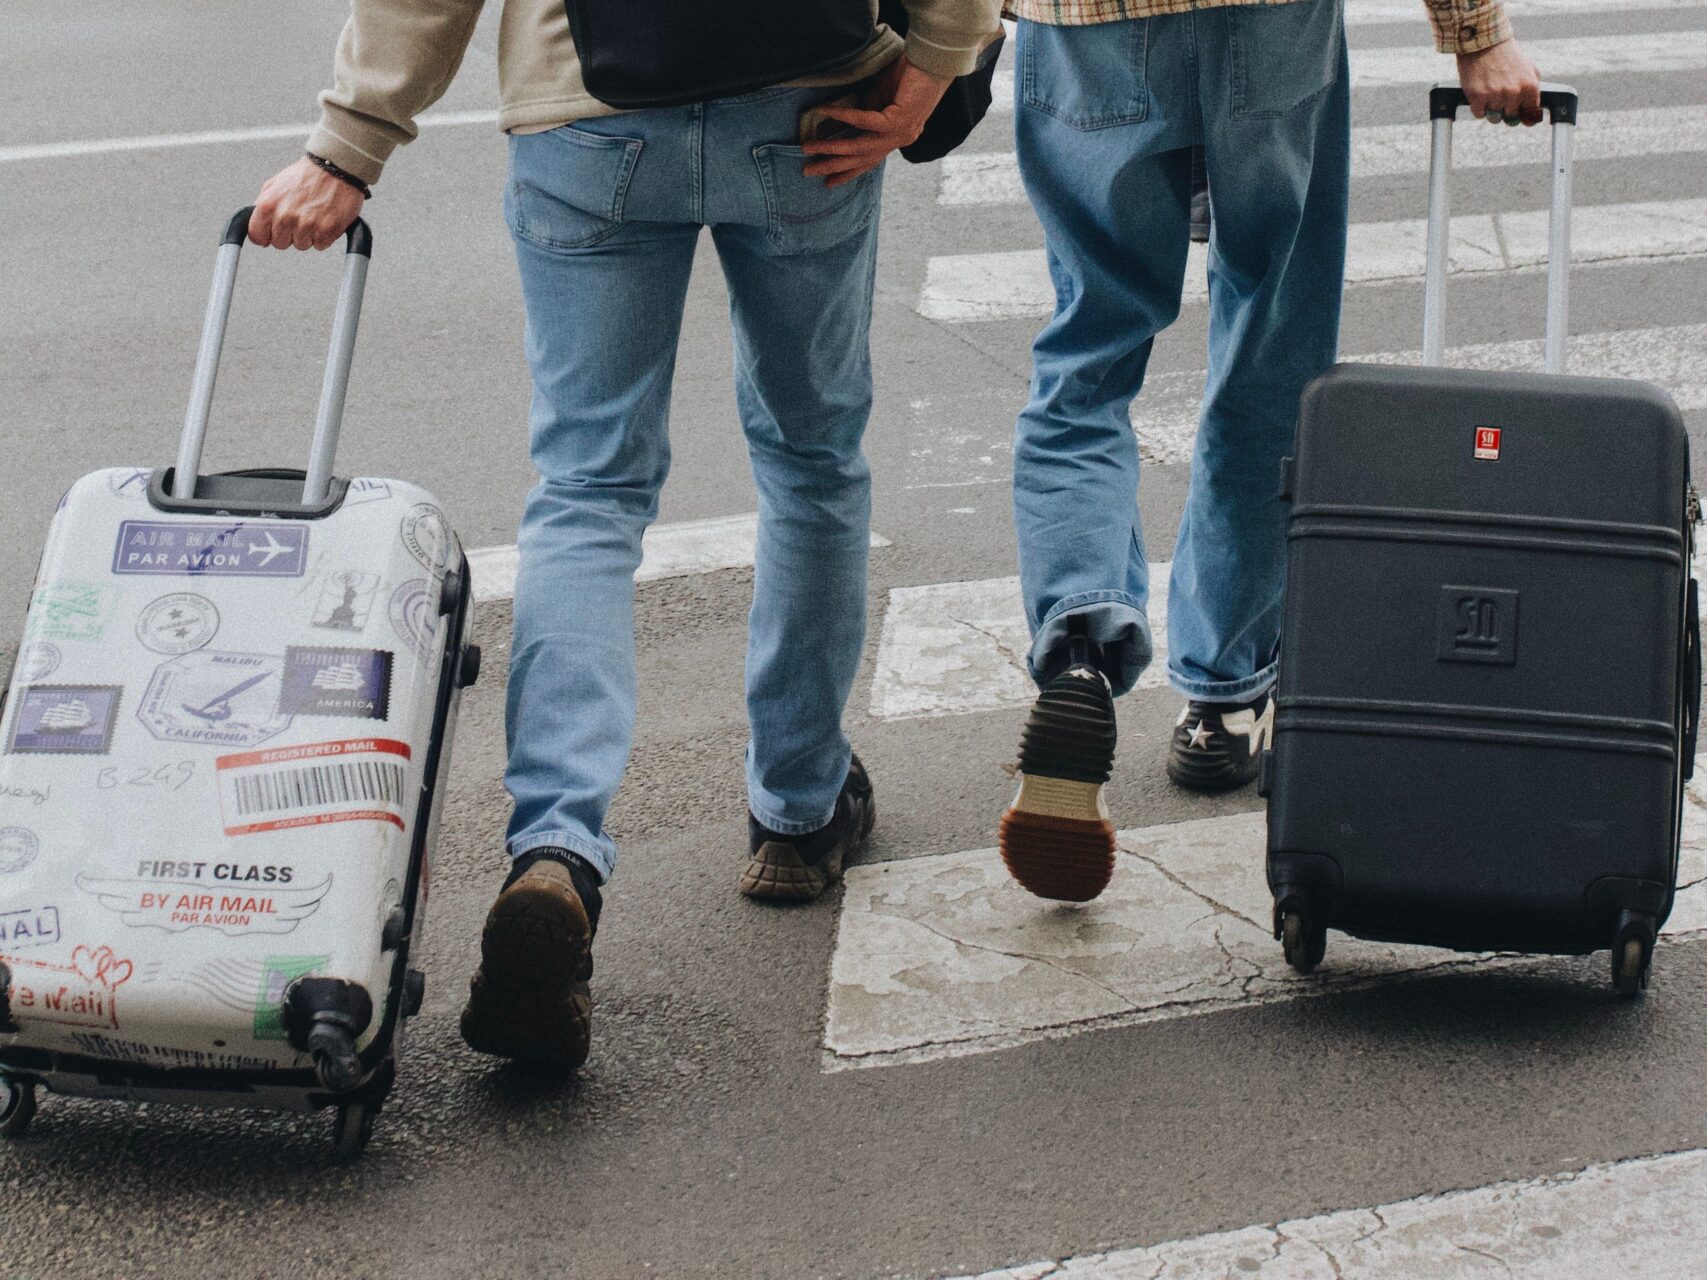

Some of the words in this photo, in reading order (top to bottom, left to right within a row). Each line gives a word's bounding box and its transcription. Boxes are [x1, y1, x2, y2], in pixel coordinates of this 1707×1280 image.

[130, 531, 174, 547] AIR
[186, 532, 244, 547] MAIL
[127, 553, 169, 565] PAR
[177, 553, 241, 566] AVION
[211, 655, 263, 666] MALIBU
[316, 699, 374, 709] AMERICA
[165, 727, 248, 742] CALIFORNIA
[260, 744, 341, 762] REGISTERED
[344, 741, 378, 753] MAIL
[137, 861, 207, 878] FIRST
[213, 863, 293, 883] CLASS
[140, 893, 170, 909] BY
[176, 894, 214, 911] AIR
[220, 896, 278, 914] MAIL
[171, 912, 199, 924] PAR
[203, 913, 251, 926] AVION
